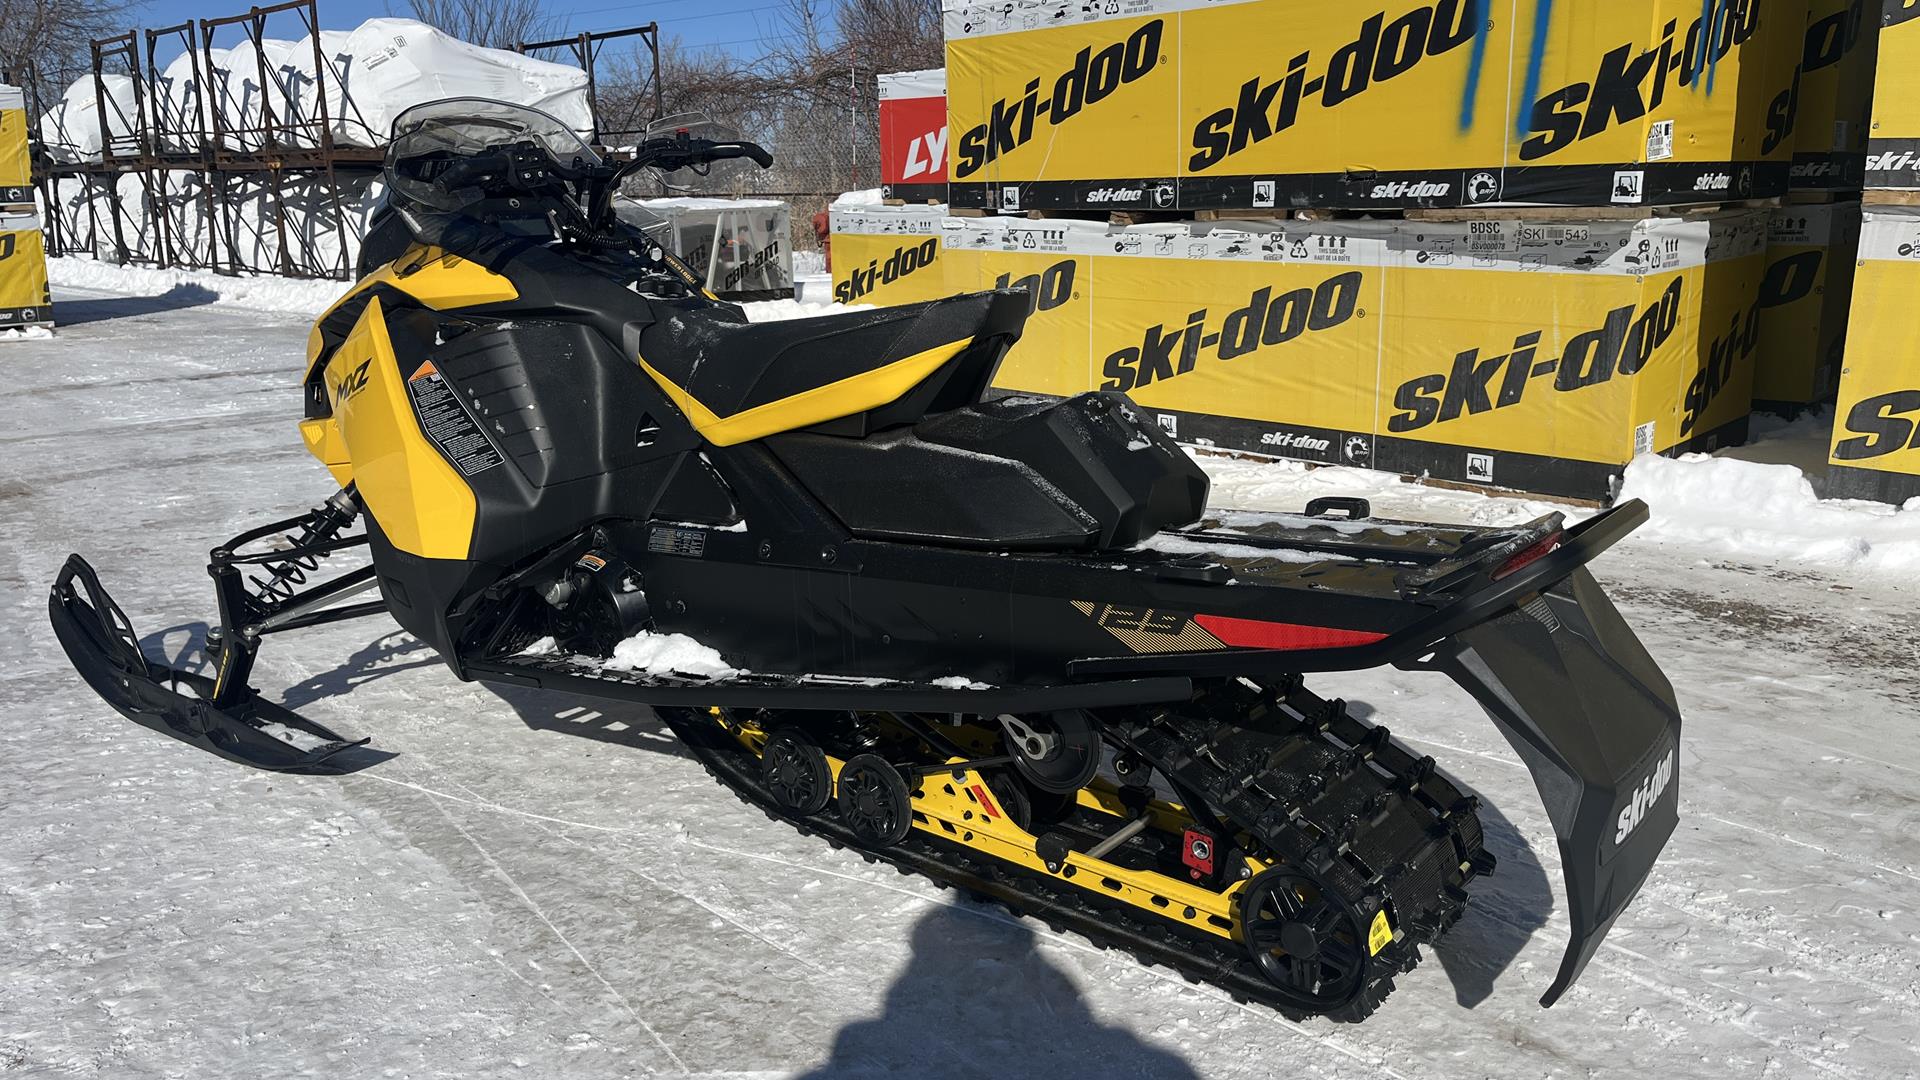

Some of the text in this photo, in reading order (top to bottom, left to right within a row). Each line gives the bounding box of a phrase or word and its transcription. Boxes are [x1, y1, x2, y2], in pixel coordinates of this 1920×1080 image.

[955, 19, 1164, 179] ski-doo
[1188, 0, 1480, 173] ski-doo
[1519, 0, 1760, 161] ski-doo
[902, 125, 948, 180] LY
[1086, 188, 1143, 203] ski-doo
[1370, 181, 1450, 199] ski-doo
[1470, 222, 1500, 234] BDSC
[1523, 229, 1588, 241] SKI 543
[725, 240, 779, 290] can-am
[833, 238, 937, 304] ski-doo
[1100, 271, 1362, 392] ski-doo
[1387, 276, 1682, 433] ski-doo
[335, 357, 373, 408] MXZ
[1260, 431, 1330, 451] ski-doo
[1614, 748, 1673, 845] ski-doo
